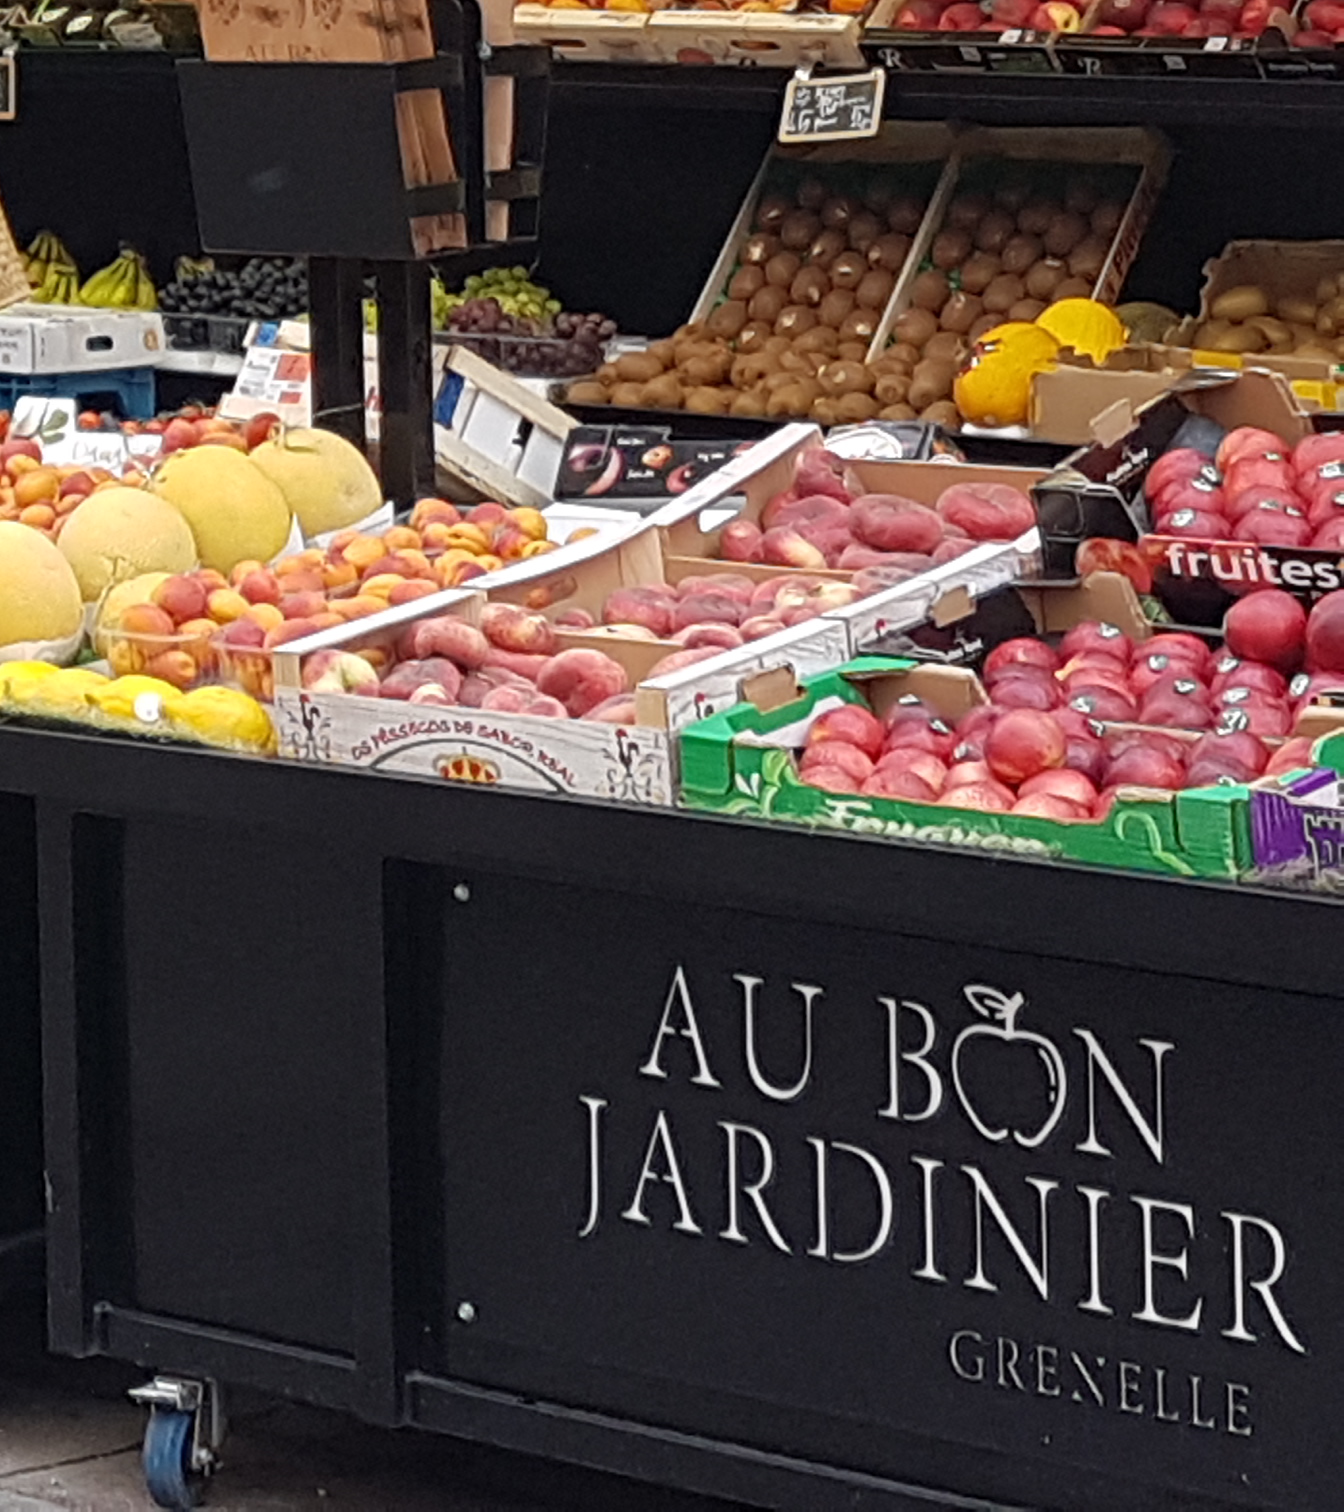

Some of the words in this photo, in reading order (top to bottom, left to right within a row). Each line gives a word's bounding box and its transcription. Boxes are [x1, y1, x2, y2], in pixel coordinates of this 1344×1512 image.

[1164, 542, 1342, 589] fruites
[638, 964, 825, 1101] AU
[878, 983, 1177, 1166] BON
[578, 1094, 1308, 1356] JARDINIER
[949, 1328, 1253, 1438] GRENELLE
